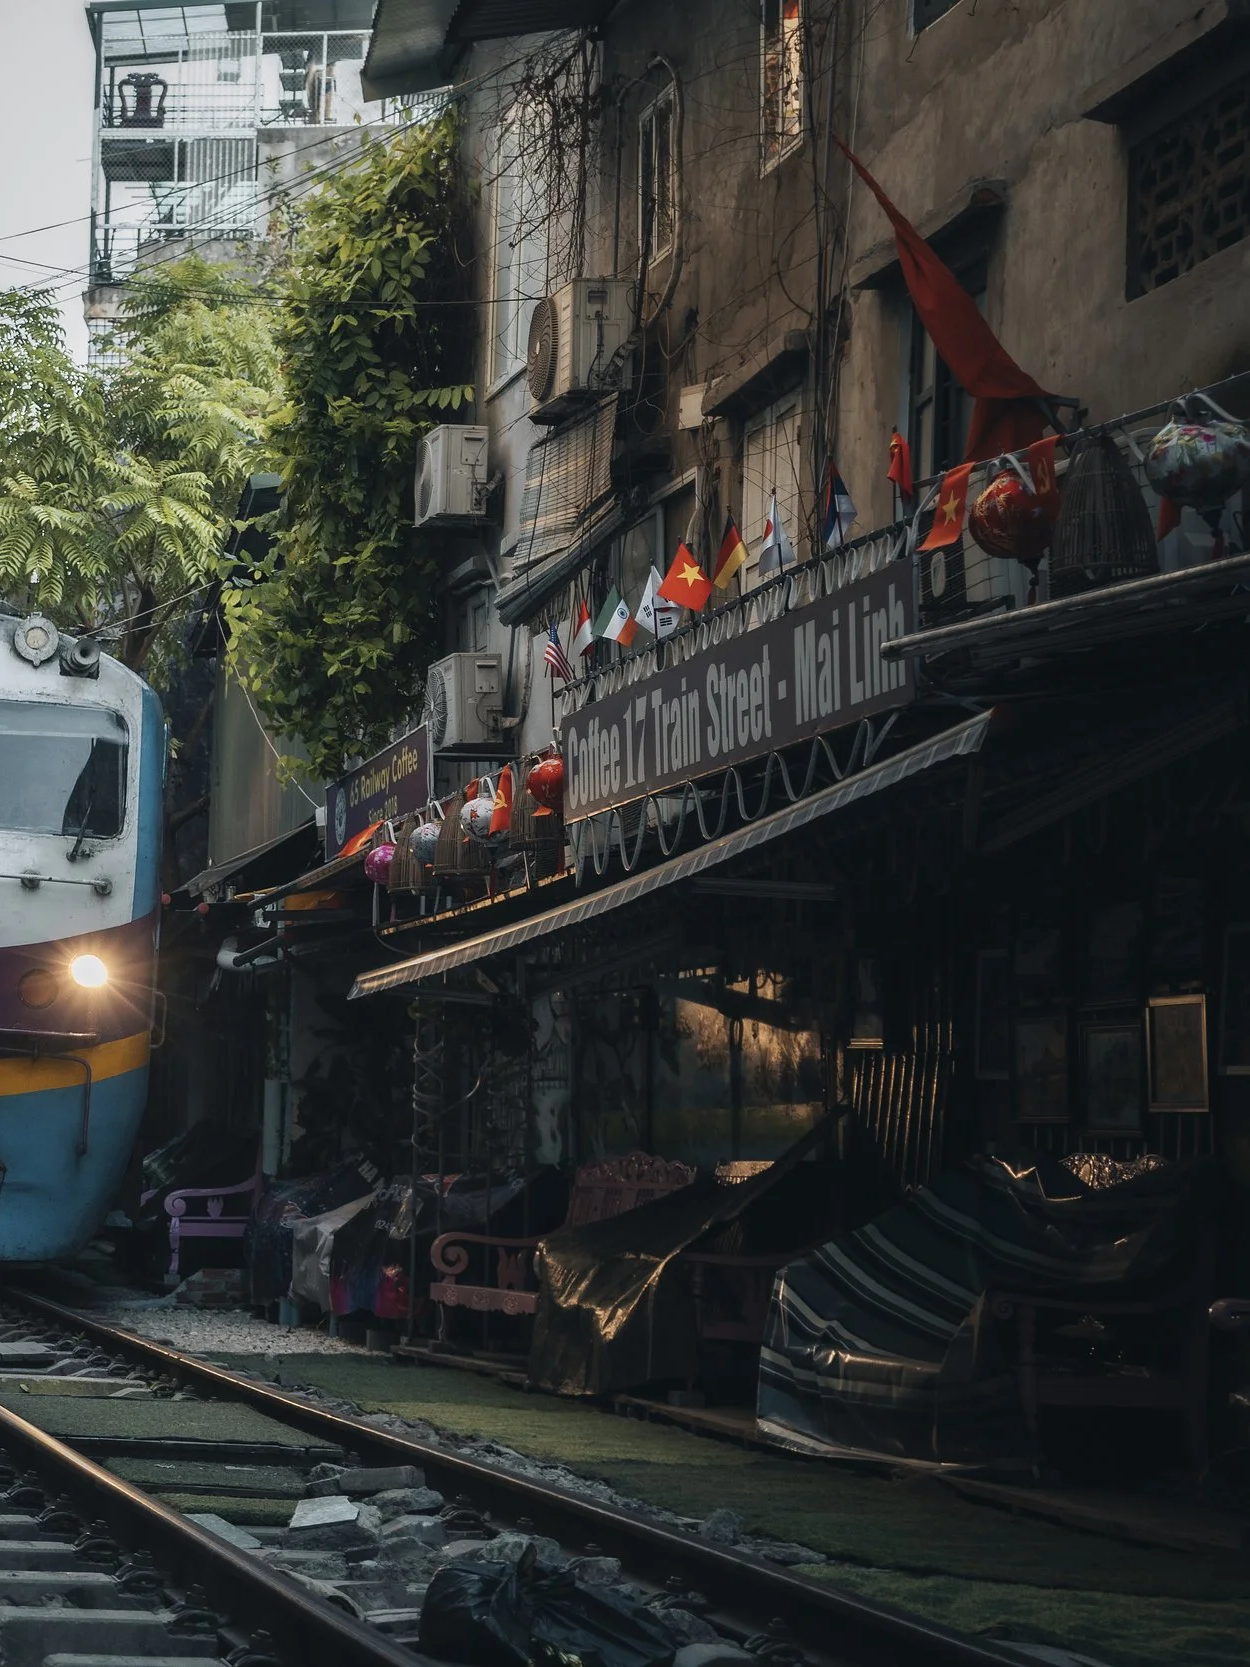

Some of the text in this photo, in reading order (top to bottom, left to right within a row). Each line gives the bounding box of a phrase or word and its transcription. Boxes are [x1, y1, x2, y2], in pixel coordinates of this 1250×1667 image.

[568, 715, 621, 810] Coffee
[623, 690, 648, 789] 17
[652, 677, 701, 777] Train
[706, 644, 772, 758] Street
[794, 609, 841, 726] Mai
[849, 583, 906, 706] Linh
[350, 745, 418, 808] 65 Railway Coffee
